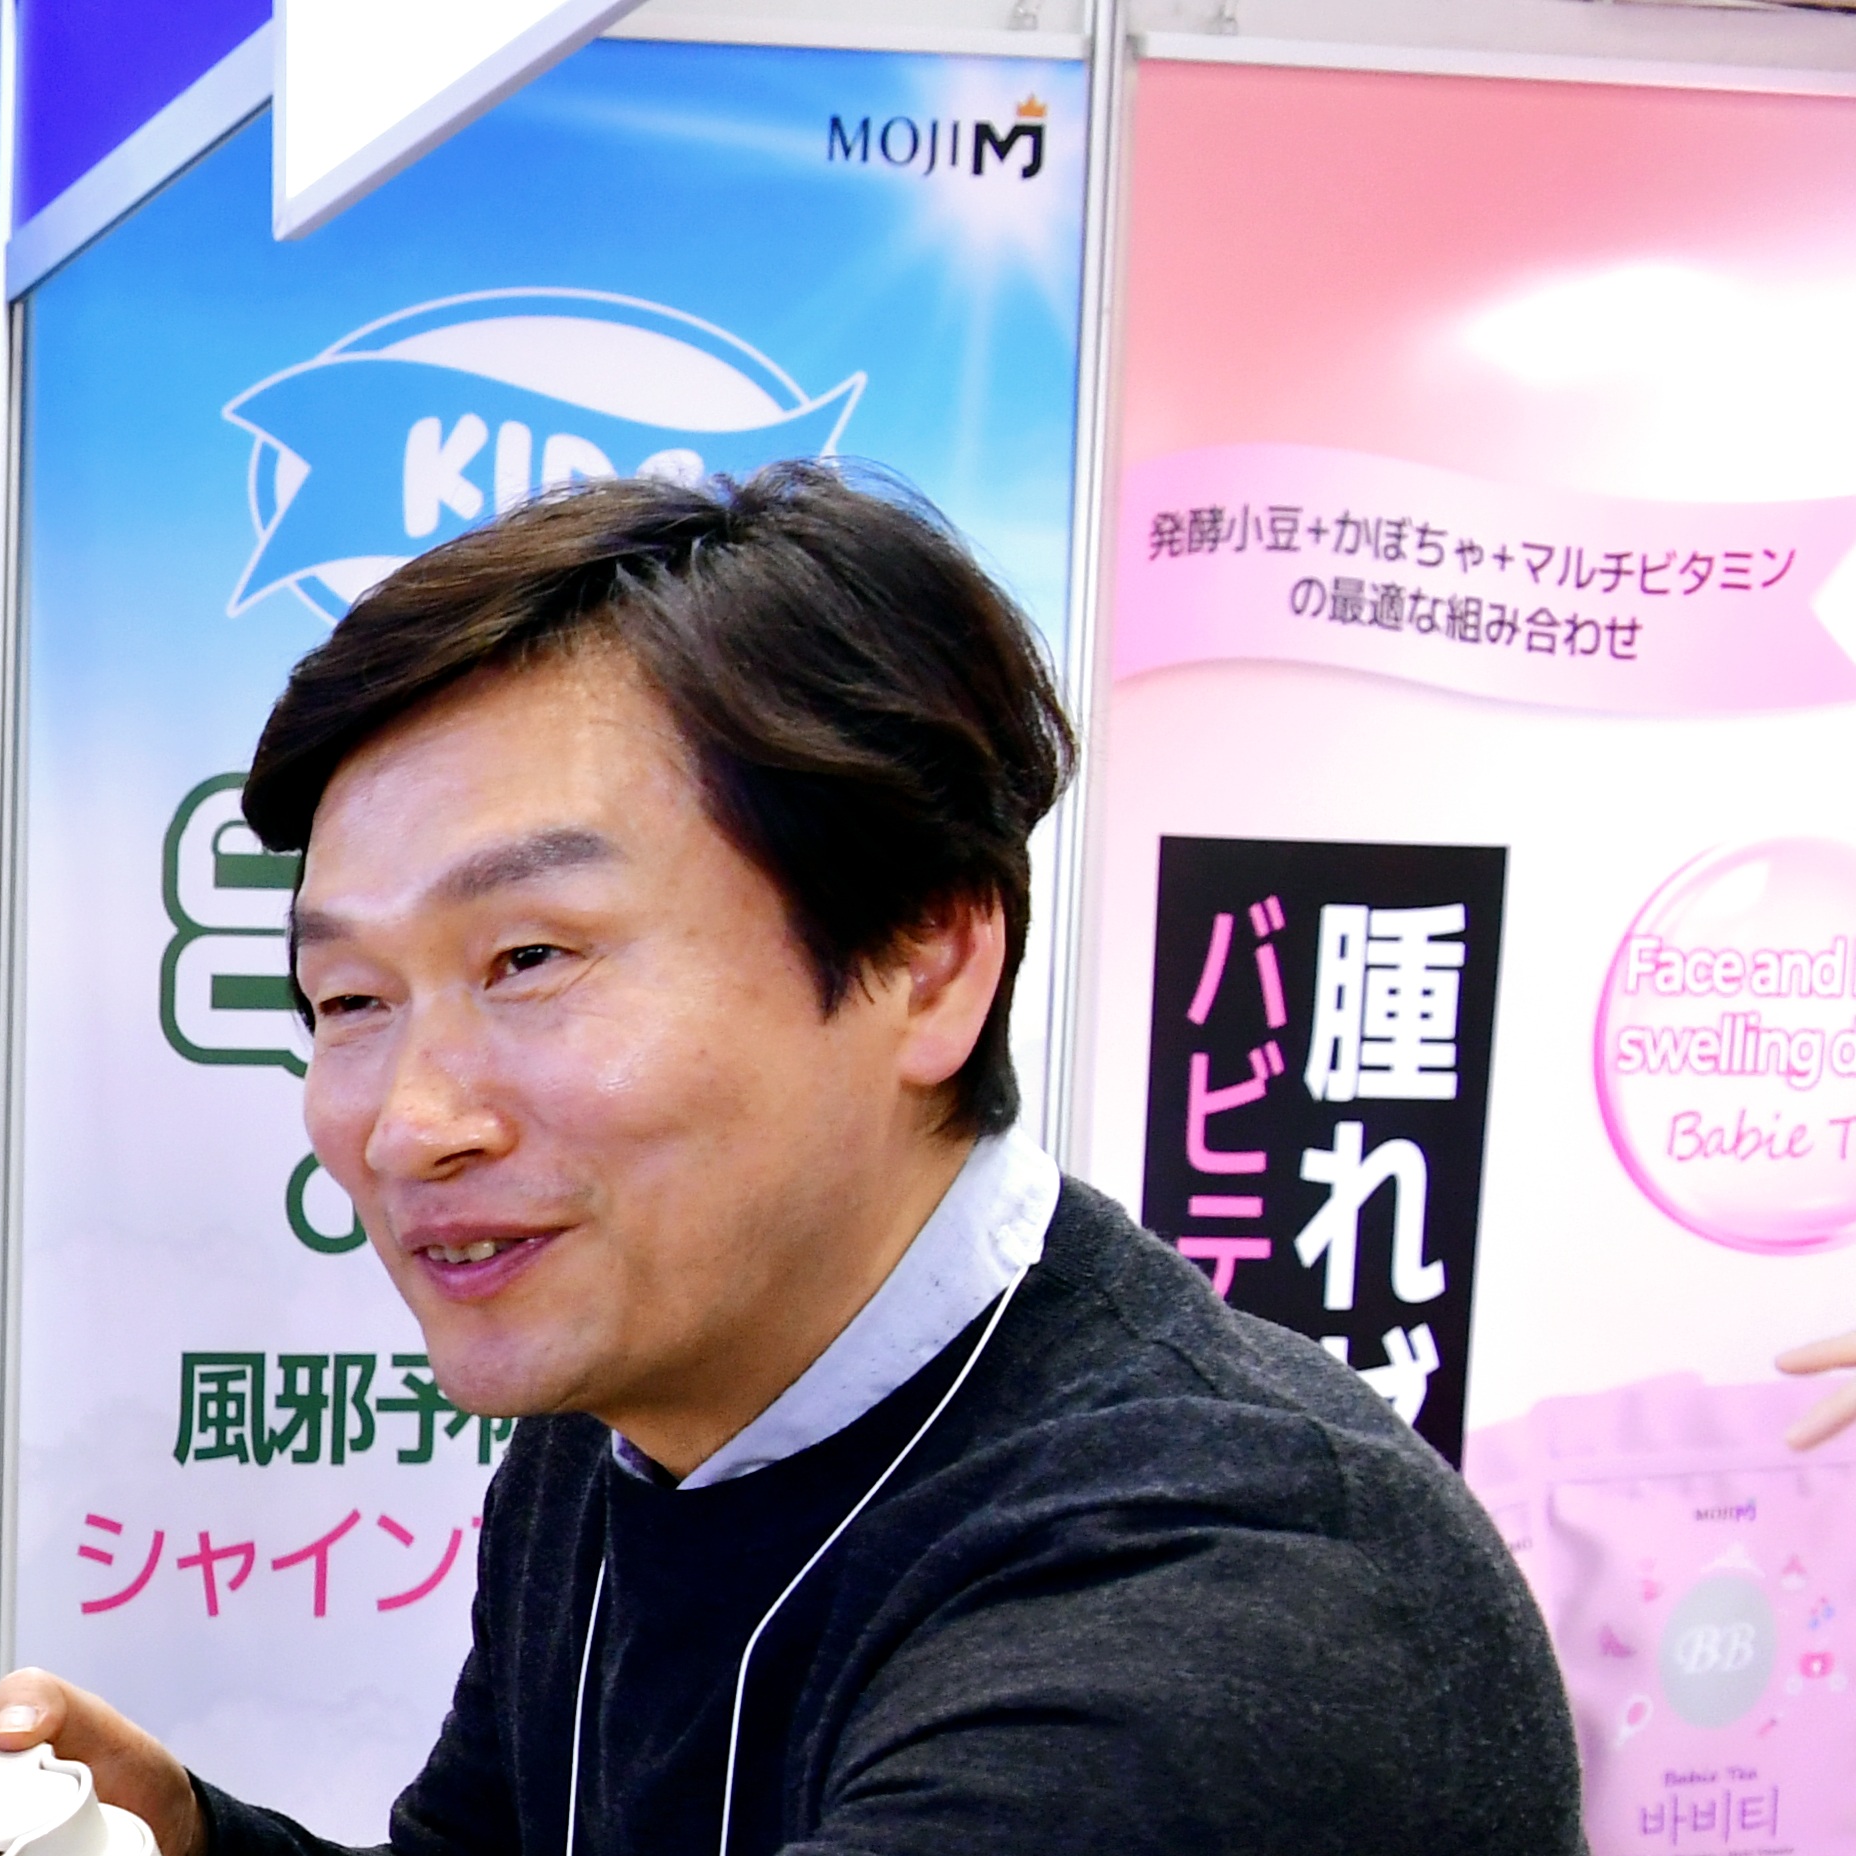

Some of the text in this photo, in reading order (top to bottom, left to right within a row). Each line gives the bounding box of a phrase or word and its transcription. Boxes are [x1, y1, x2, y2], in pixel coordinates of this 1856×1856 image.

[828, 113, 961, 178] MOJI
[1289, 575, 1644, 661] の最適な組み合わせ
[1625, 934, 1849, 998] Face and
[1616, 1009, 1827, 1092] swelling
[1666, 1108, 1816, 1162] Babie
[1640, 1785, 1780, 1847] 바비티
